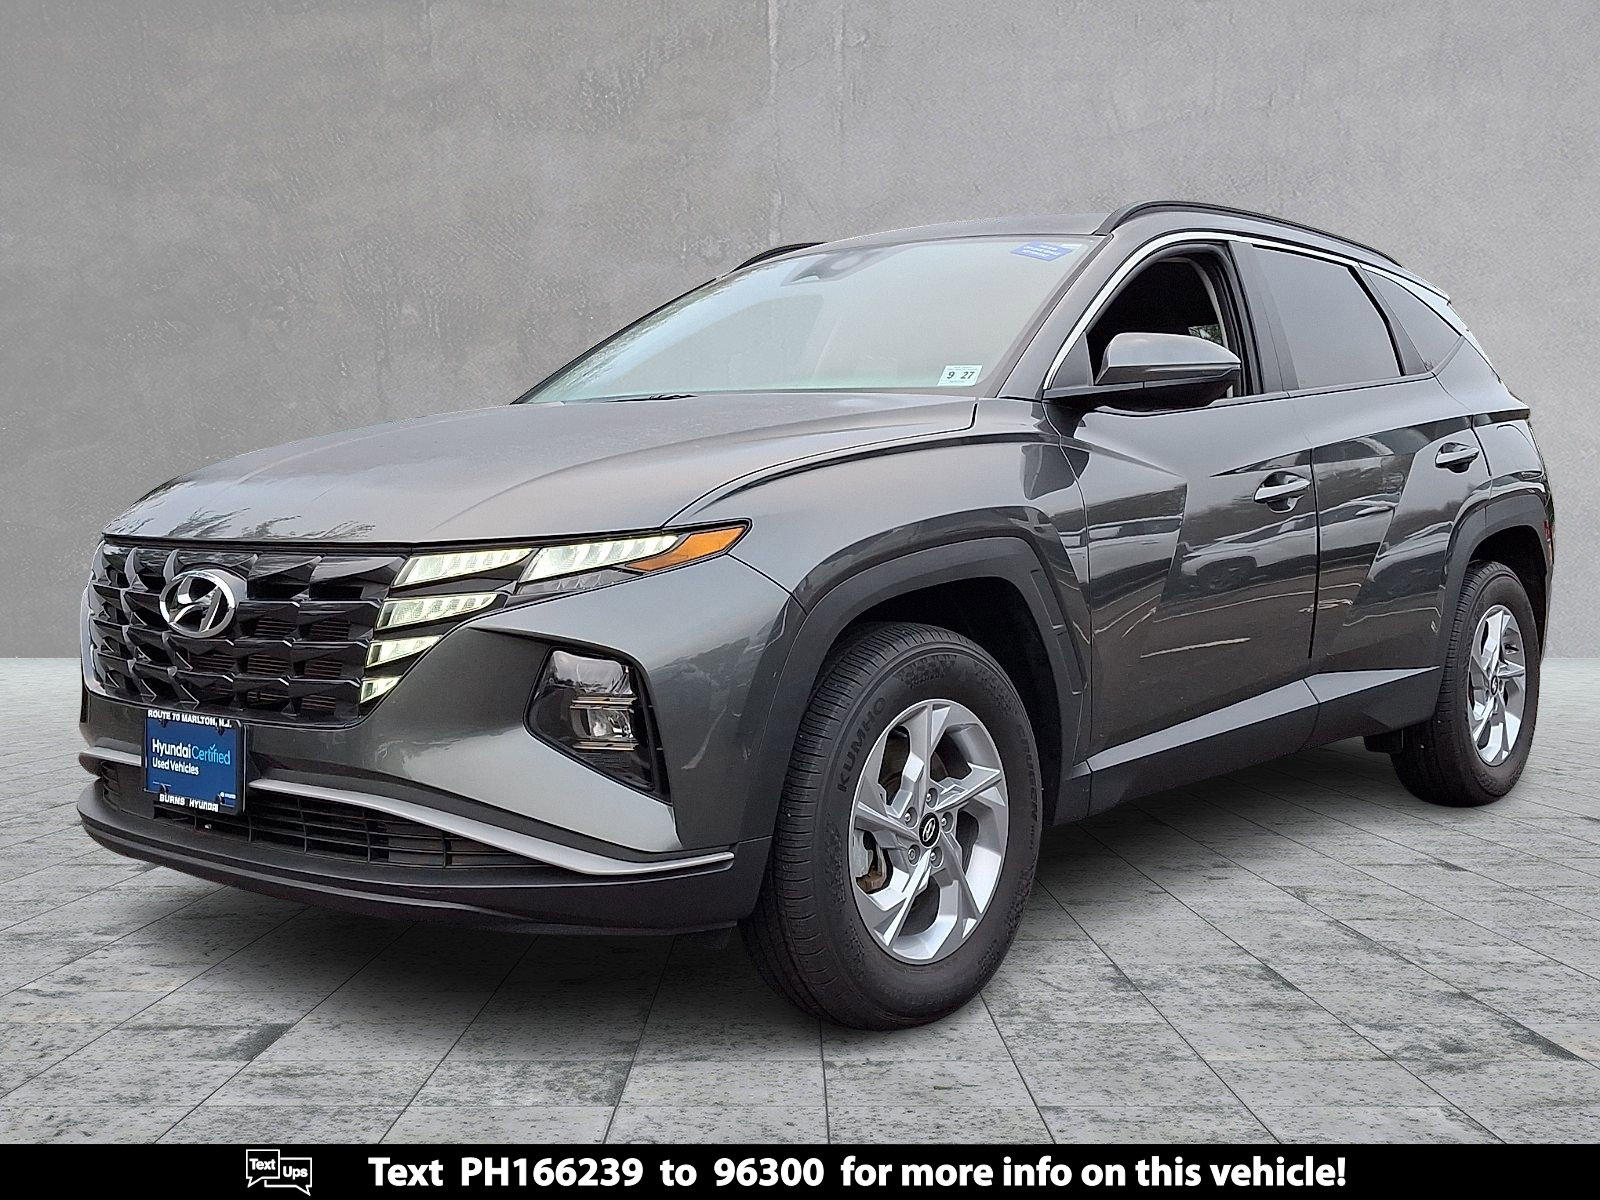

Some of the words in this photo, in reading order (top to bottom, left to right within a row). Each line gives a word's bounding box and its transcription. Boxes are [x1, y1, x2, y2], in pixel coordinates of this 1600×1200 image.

[946, 371, 955, 379] 9
[960, 371, 975, 379] 27
[148, 709, 171, 720] ROUTE
[172, 713, 181, 721] 70
[837, 697, 886, 792] KUMHO
[152, 757, 170, 770] Used
[170, 759, 200, 776] Vehicles
[159, 794, 186, 806] BURNS
